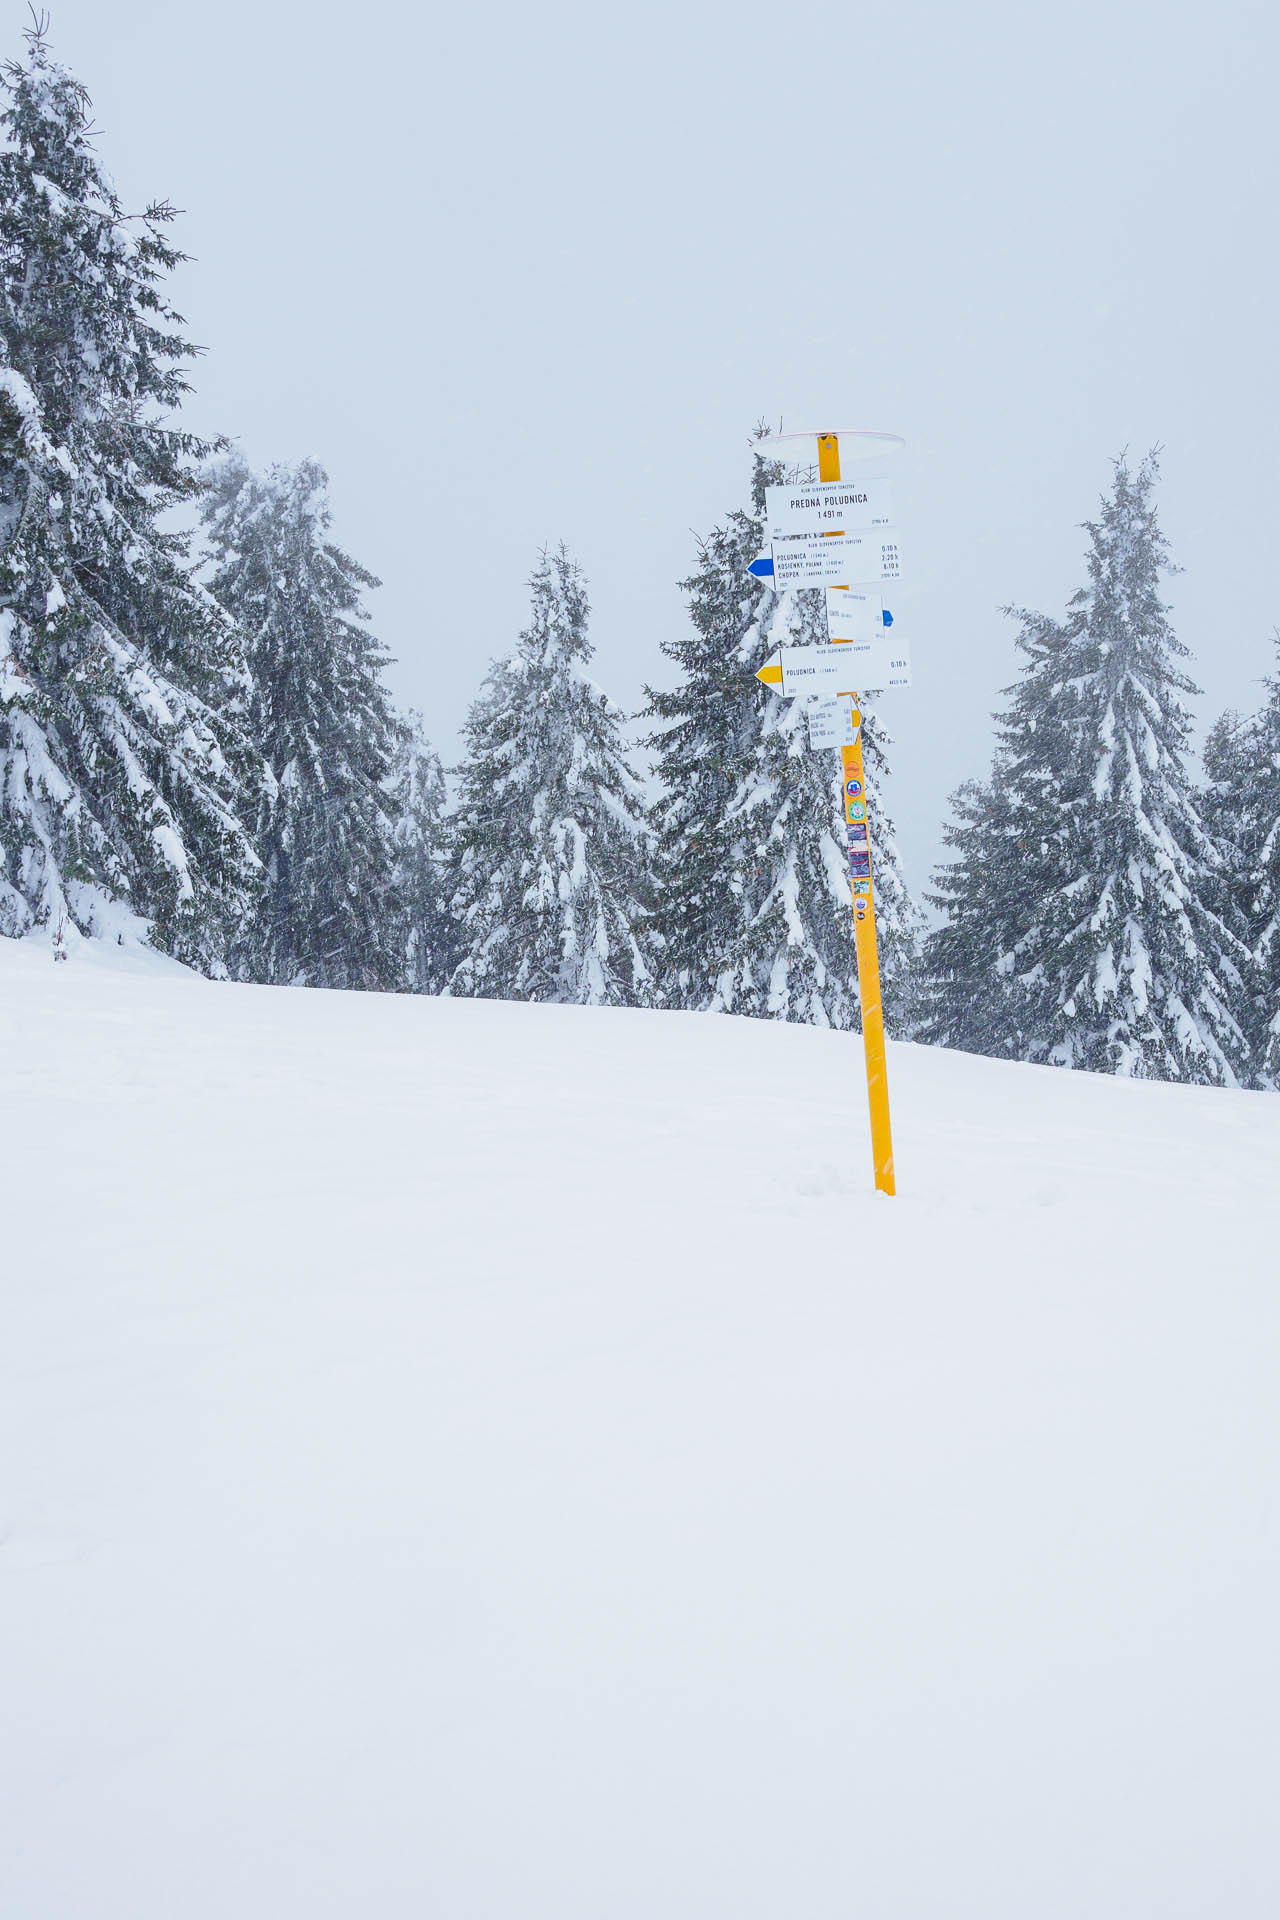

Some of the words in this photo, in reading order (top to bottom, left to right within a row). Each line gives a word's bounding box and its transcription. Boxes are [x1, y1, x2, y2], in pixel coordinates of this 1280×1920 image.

[790, 496, 820, 509] PREDNÁ
[824, 493, 868, 506] POLUDNICA
[776, 552, 807, 561] POLUDNICA
[778, 571, 800, 579] CHOPOK
[786, 667, 816, 676] POLUDNICA
